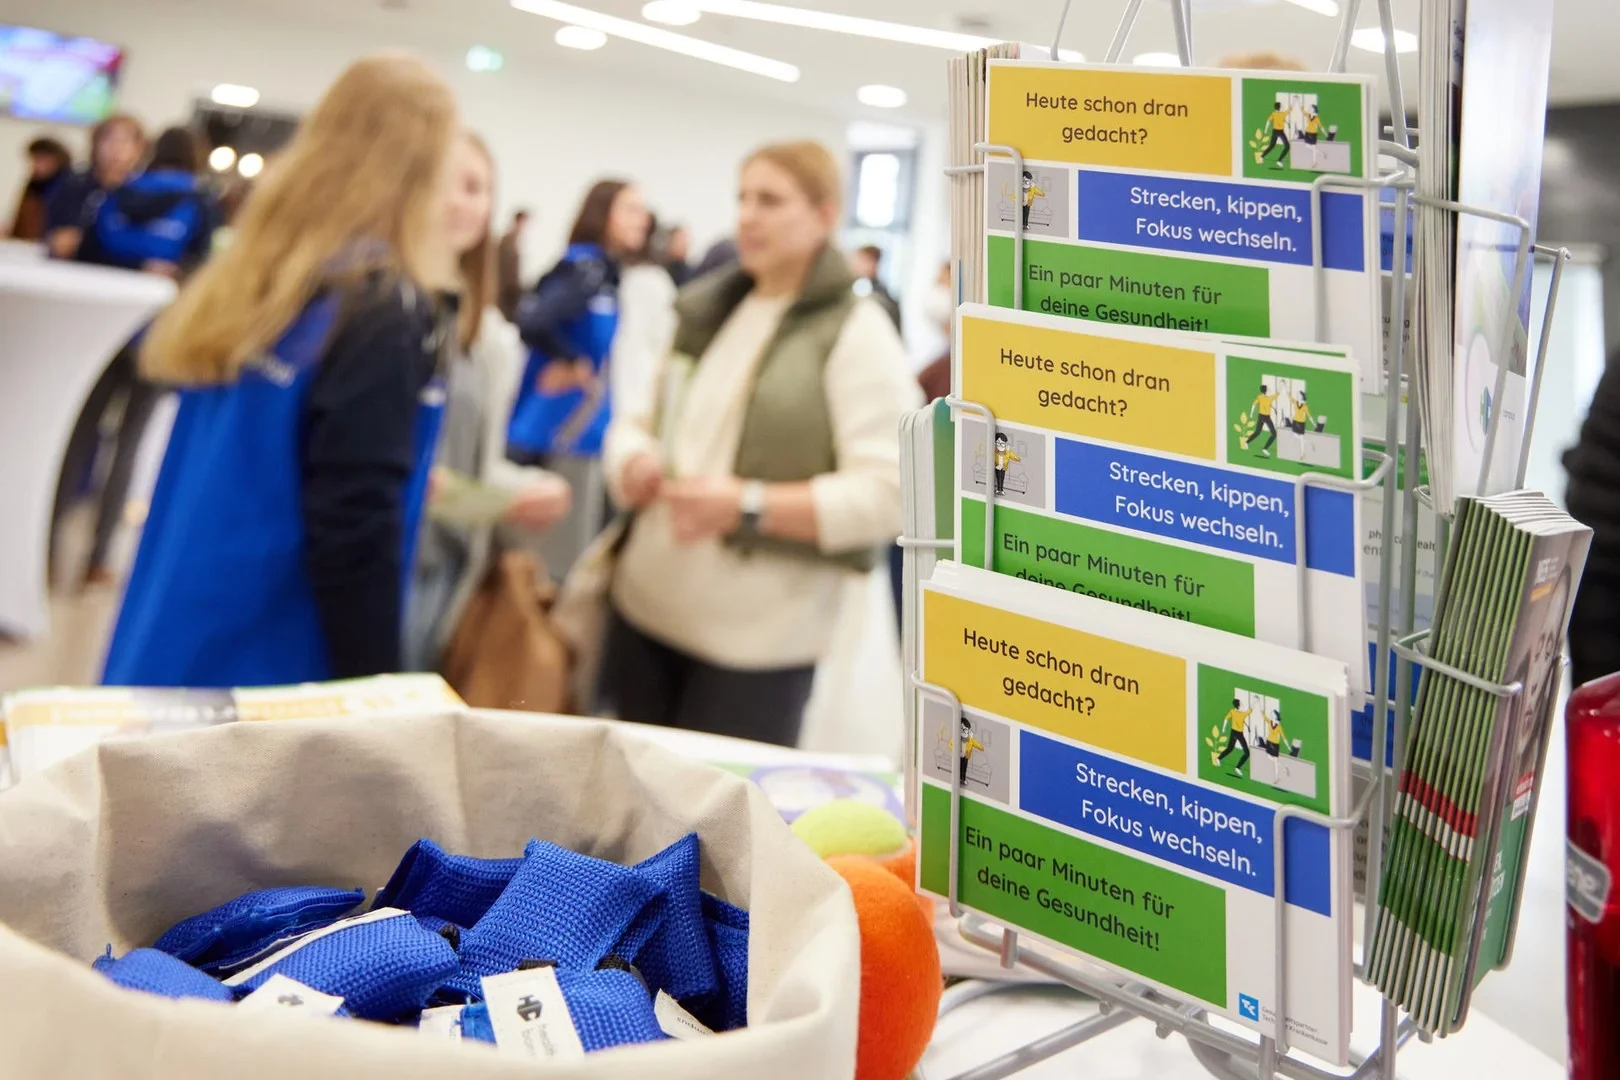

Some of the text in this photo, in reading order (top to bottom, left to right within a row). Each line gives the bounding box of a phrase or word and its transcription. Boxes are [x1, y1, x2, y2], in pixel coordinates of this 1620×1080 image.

[1026, 92, 1188, 117] Heute schon dran
[1062, 125, 1148, 145] gedacht?
[1130, 186, 1302, 223] Strecken, kippen,
[1136, 217, 1297, 252] Fokus wechseln.
[1029, 264, 1222, 305] Ein paar Minuten für
[1040, 295, 1209, 332] deine Gesundheit!
[1000, 348, 1170, 392] Heute schon dran
[1038, 389, 1128, 417] gedacht?
[1109, 461, 1289, 518] Strecken, kippen,
[1115, 495, 1283, 549] Fokus wechseln.
[1003, 532, 1205, 597] Ein paar Minuten für
[964, 627, 1139, 695] Heute schon dran
[1002, 676, 1096, 716] gedacht?
[1076, 762, 1262, 844] Strecken, kippen,
[1082, 799, 1256, 876] Fokus wechseln.
[965, 825, 1175, 919] Ein paar Minuten für
[976, 865, 1160, 952] deine Gesundheit!
